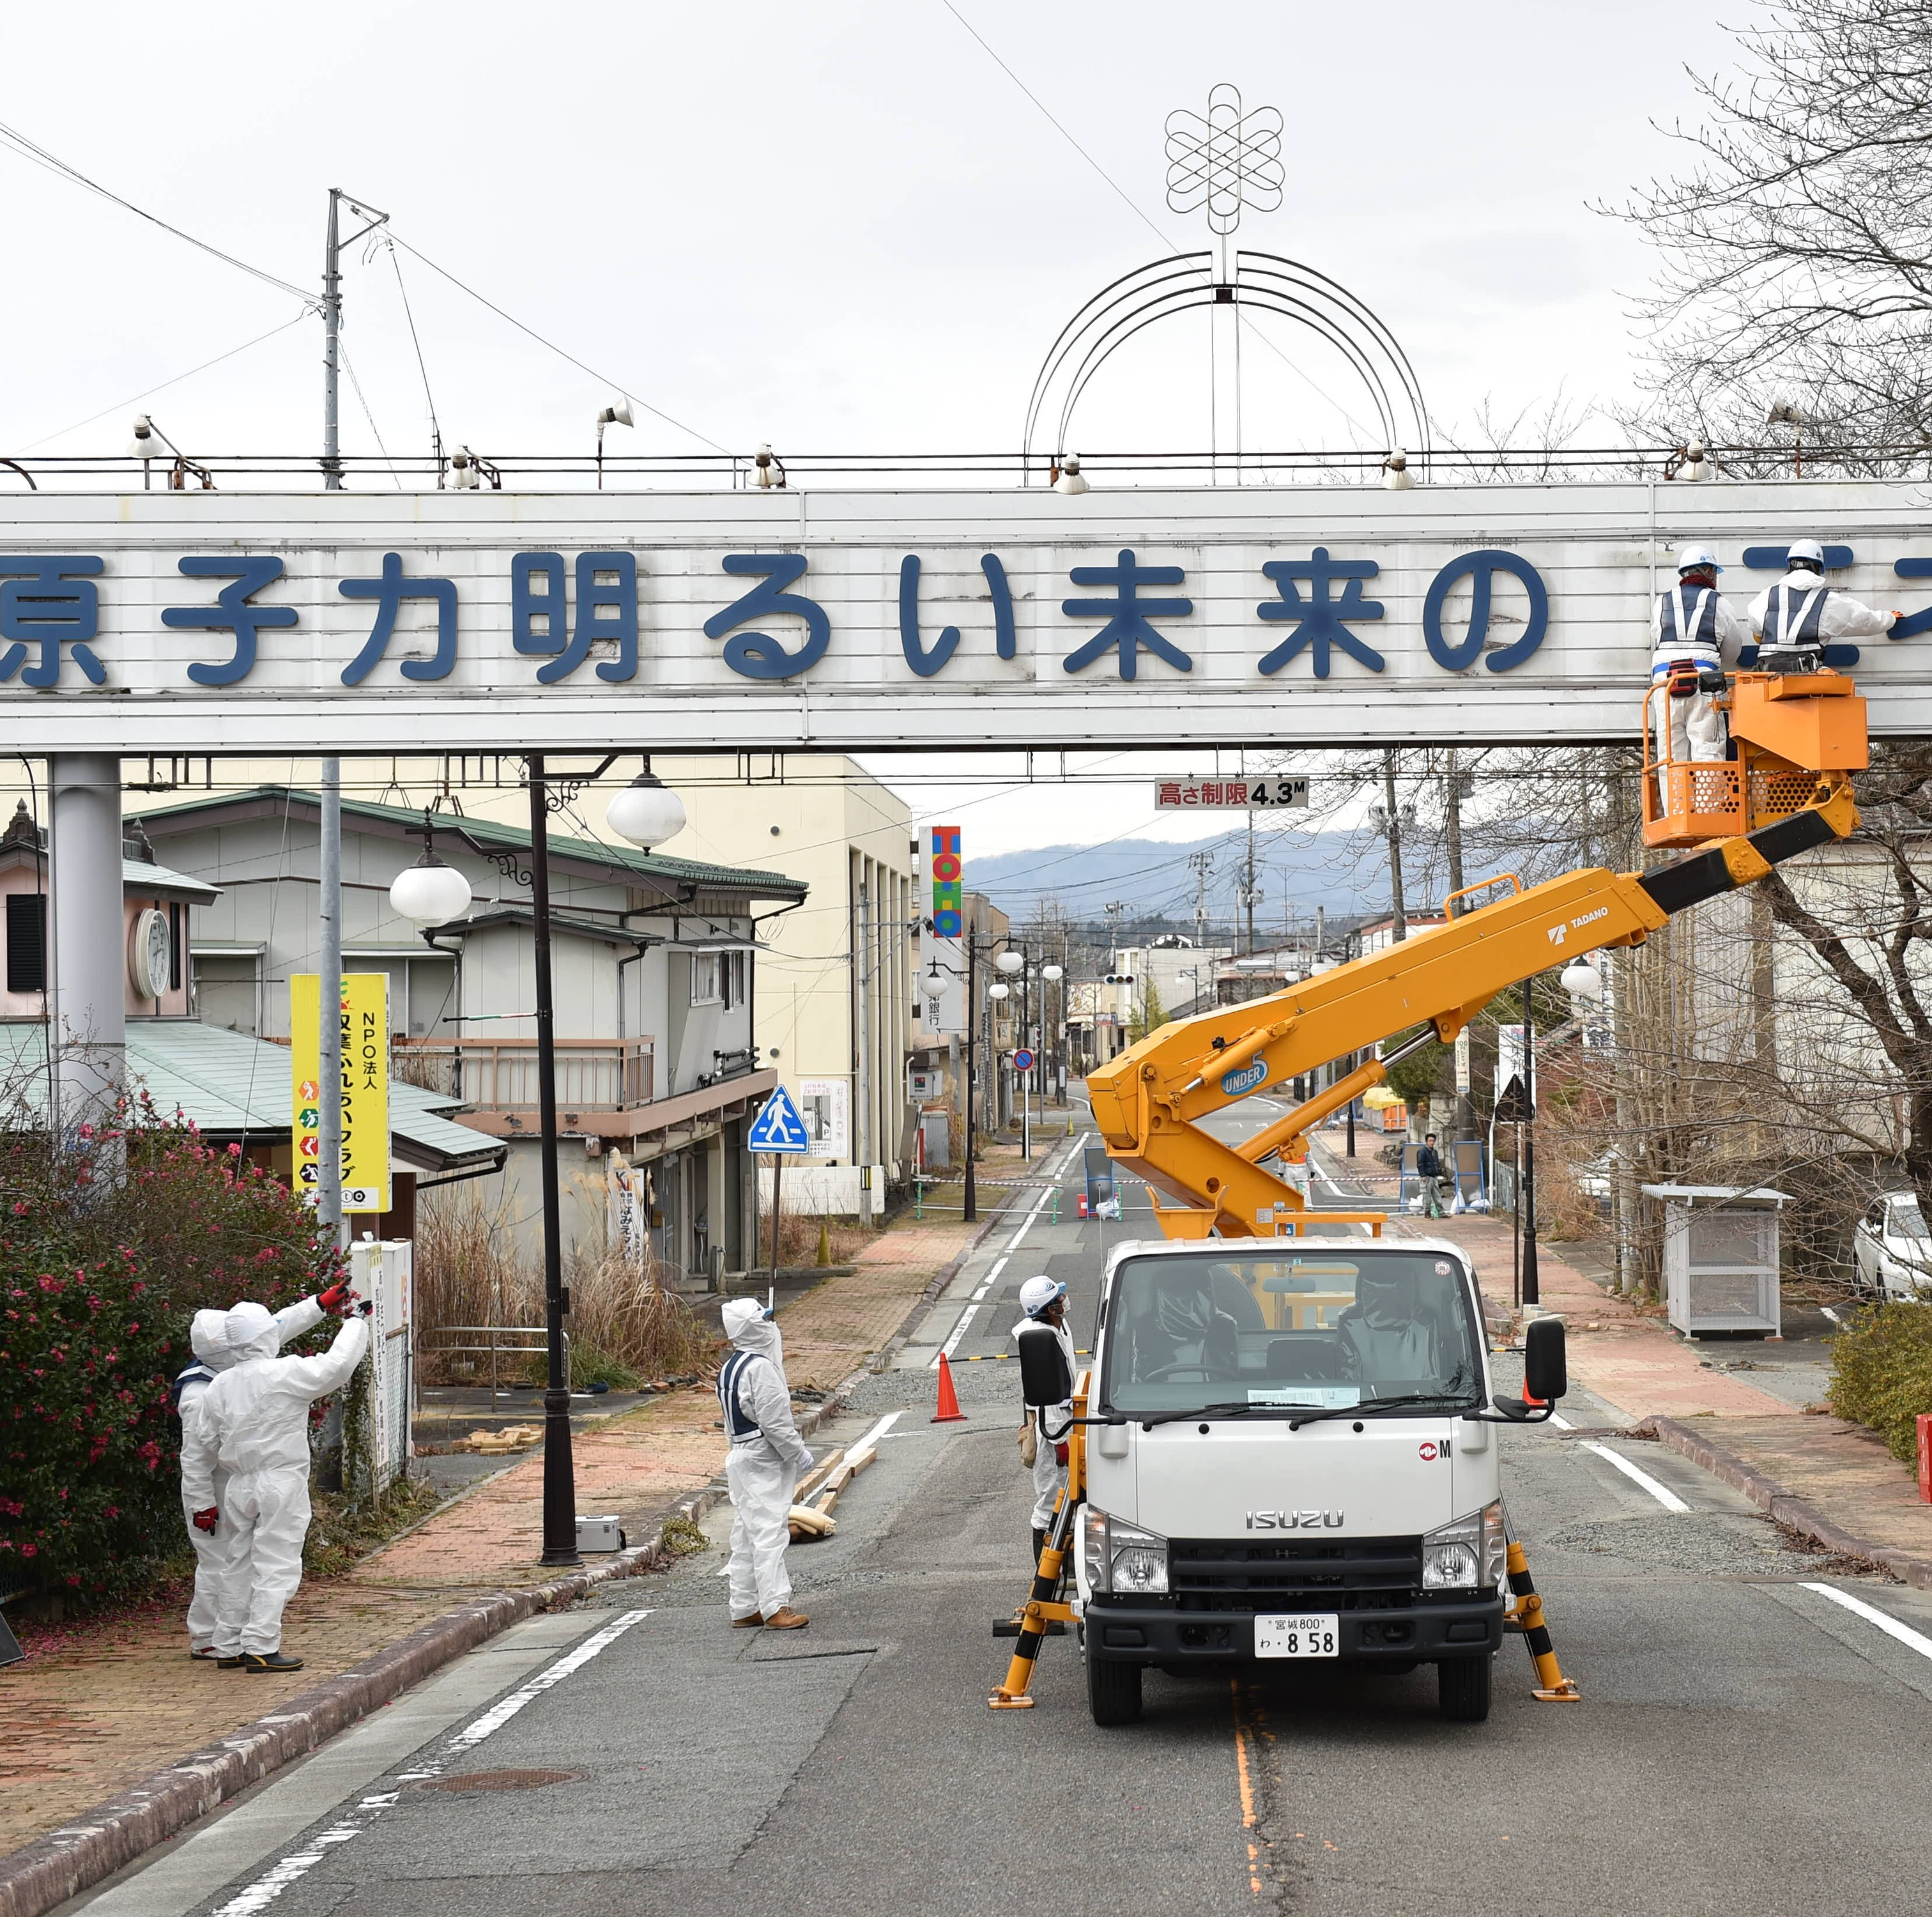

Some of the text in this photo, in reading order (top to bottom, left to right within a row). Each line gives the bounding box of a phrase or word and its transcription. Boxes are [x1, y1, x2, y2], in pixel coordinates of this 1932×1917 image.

[1570, 906, 1609, 928] TADANO
[362, 1012, 378, 1090] NPO法人
[1225, 1049, 1268, 1093] UNDER 5
[1439, 1440, 1451, 1458] M
[1246, 1509, 1344, 1529] ISUZU
